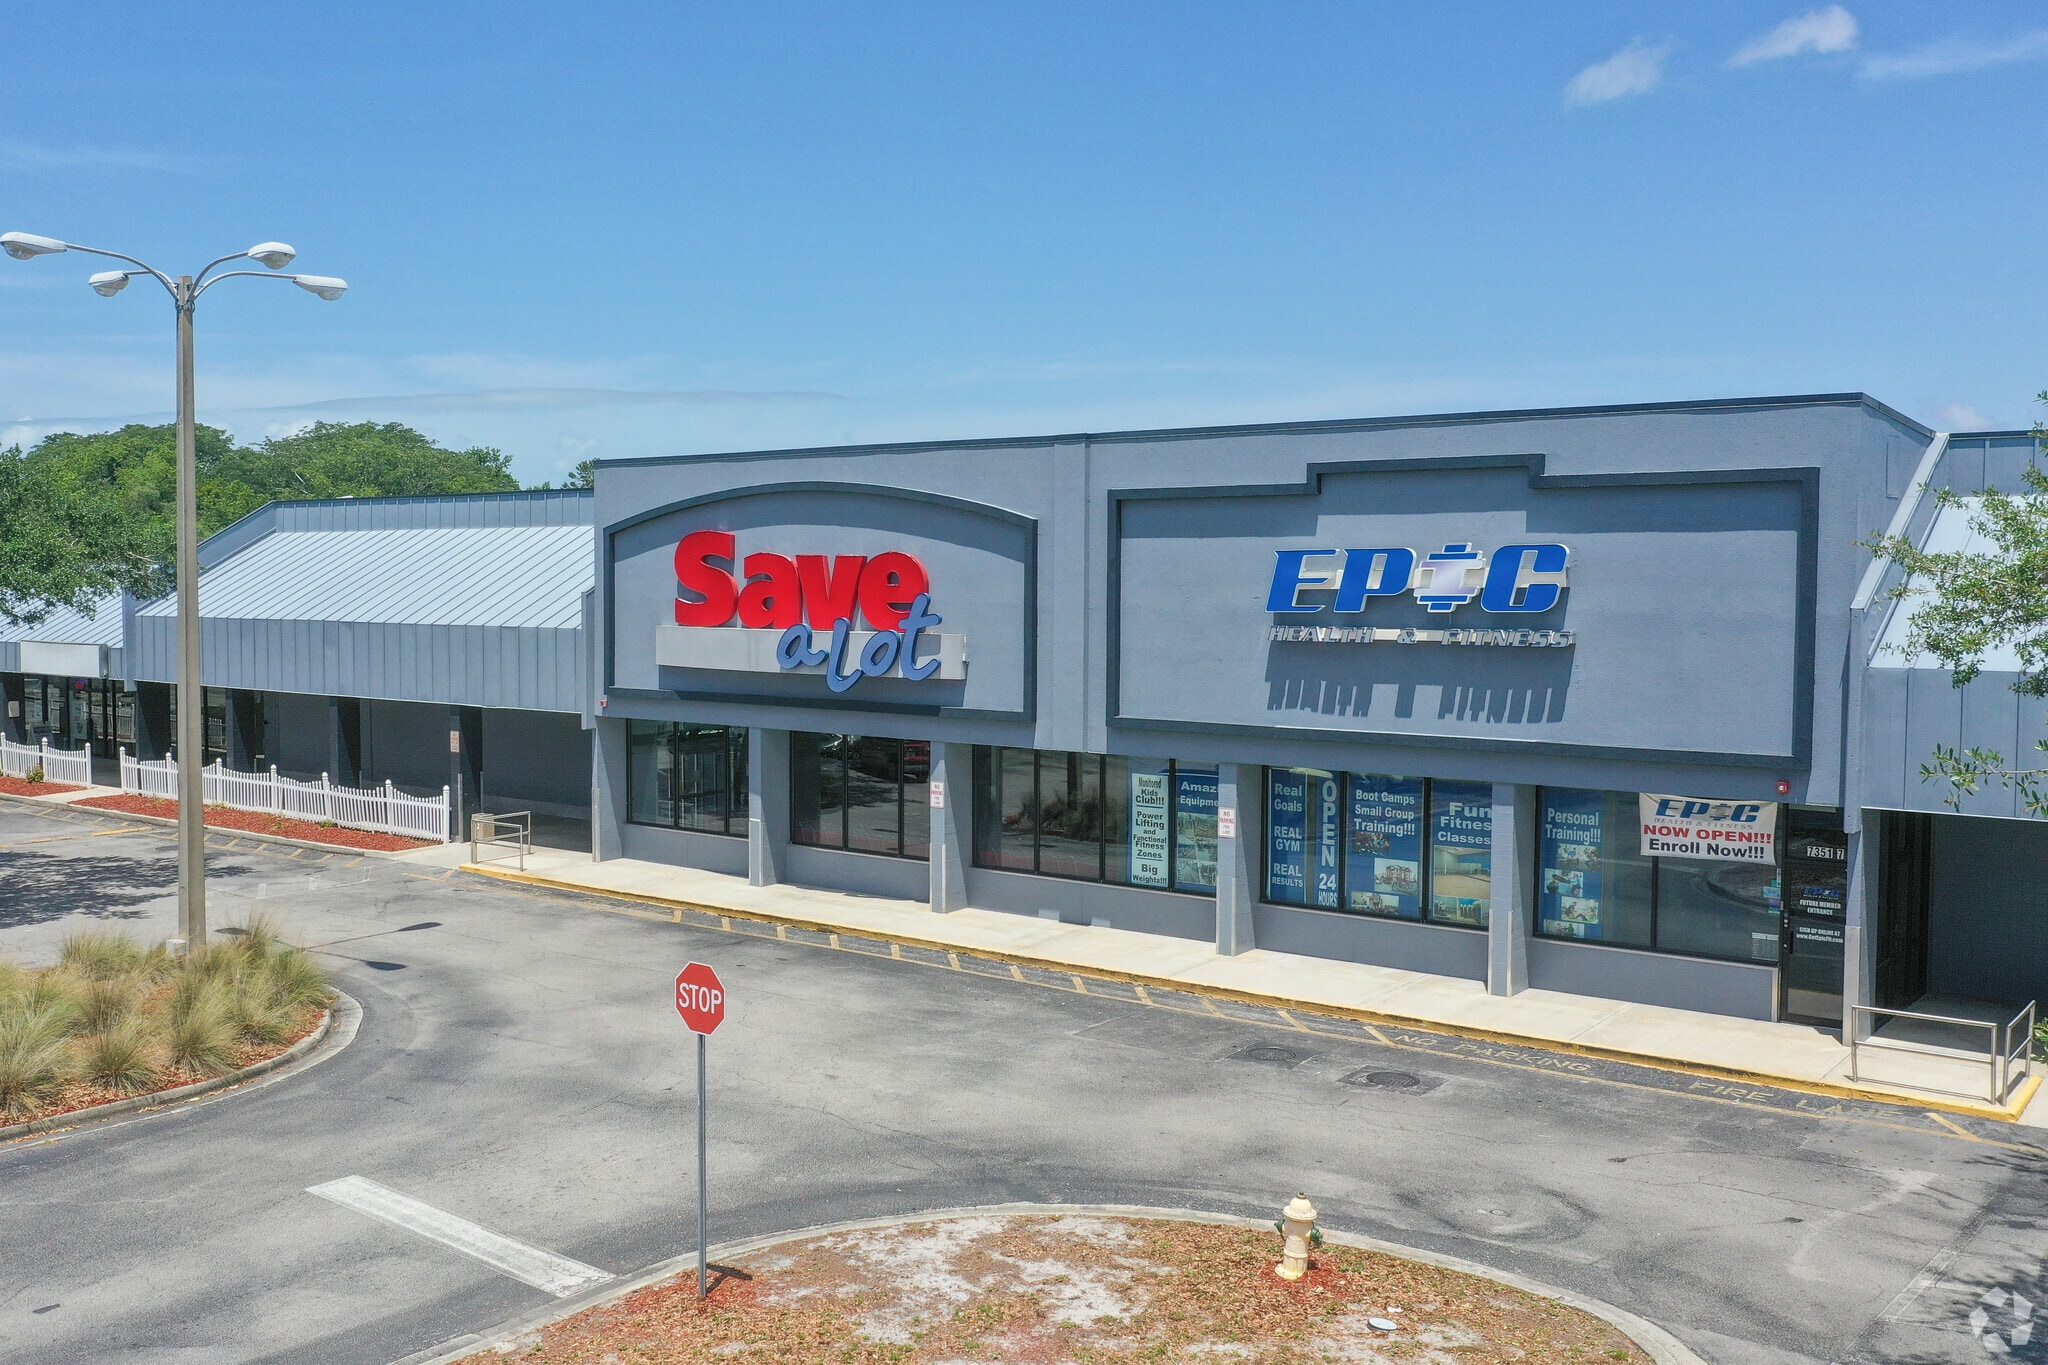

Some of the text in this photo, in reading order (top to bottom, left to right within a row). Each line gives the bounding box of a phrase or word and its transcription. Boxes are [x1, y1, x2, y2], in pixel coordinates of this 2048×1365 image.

[674, 530, 930, 632] Save
[1264, 542, 1571, 613] EPIC
[1268, 625, 1575, 648] HEALTH & FITNESS
[1138, 776, 1162, 789] Monitored
[1181, 781, 1218, 793] Amaz
[1274, 783, 1303, 797] Real
[1135, 795, 1165, 806] Club!!!
[1141, 789, 1159, 797] Kids
[1355, 789, 1415, 805] Boot Camps
[1180, 795, 1219, 807] Equipme
[1274, 798, 1303, 813] Goals
[1136, 811, 1163, 820] Power
[1354, 804, 1415, 820] Small Group
[1449, 802, 1492, 818] Fun
[1547, 807, 1600, 827] Personal
[1655, 798, 1761, 823] EPIC
[1135, 818, 1165, 830] Lifting
[1321, 780, 1338, 867] OPEN
[1353, 818, 1416, 837] Training!!!
[1654, 817, 1692, 827] HEALTH
[1707, 822, 1754, 830] FITNESS
[1133, 834, 1167, 844] Functional
[1273, 825, 1303, 840] REAL
[1437, 831, 1492, 845] Classes
[1545, 824, 1601, 845] Training!!!
[1643, 824, 1772, 844] NOW OPEN!!!
[1135, 840, 1165, 850] Fitness
[1275, 838, 1301, 852] GYM
[1648, 838, 1765, 859] Enroll Now!!!
[1137, 849, 1163, 859] Zones
[1141, 863, 1158, 875] Big
[1273, 863, 1303, 877] REAL
[1272, 876, 1304, 888] RESULTS
[1318, 873, 1337, 890] 24
[1318, 891, 1338, 907] HOURS
[1799, 899, 1842, 909] FUTURE MEMBER
[1807, 907, 1833, 915] ENTRANCE
[678, 982, 722, 1015] STOP
[1394, 1034, 1592, 1073] NO PARKING
[1688, 1081, 1906, 1120] FIRE LANE
